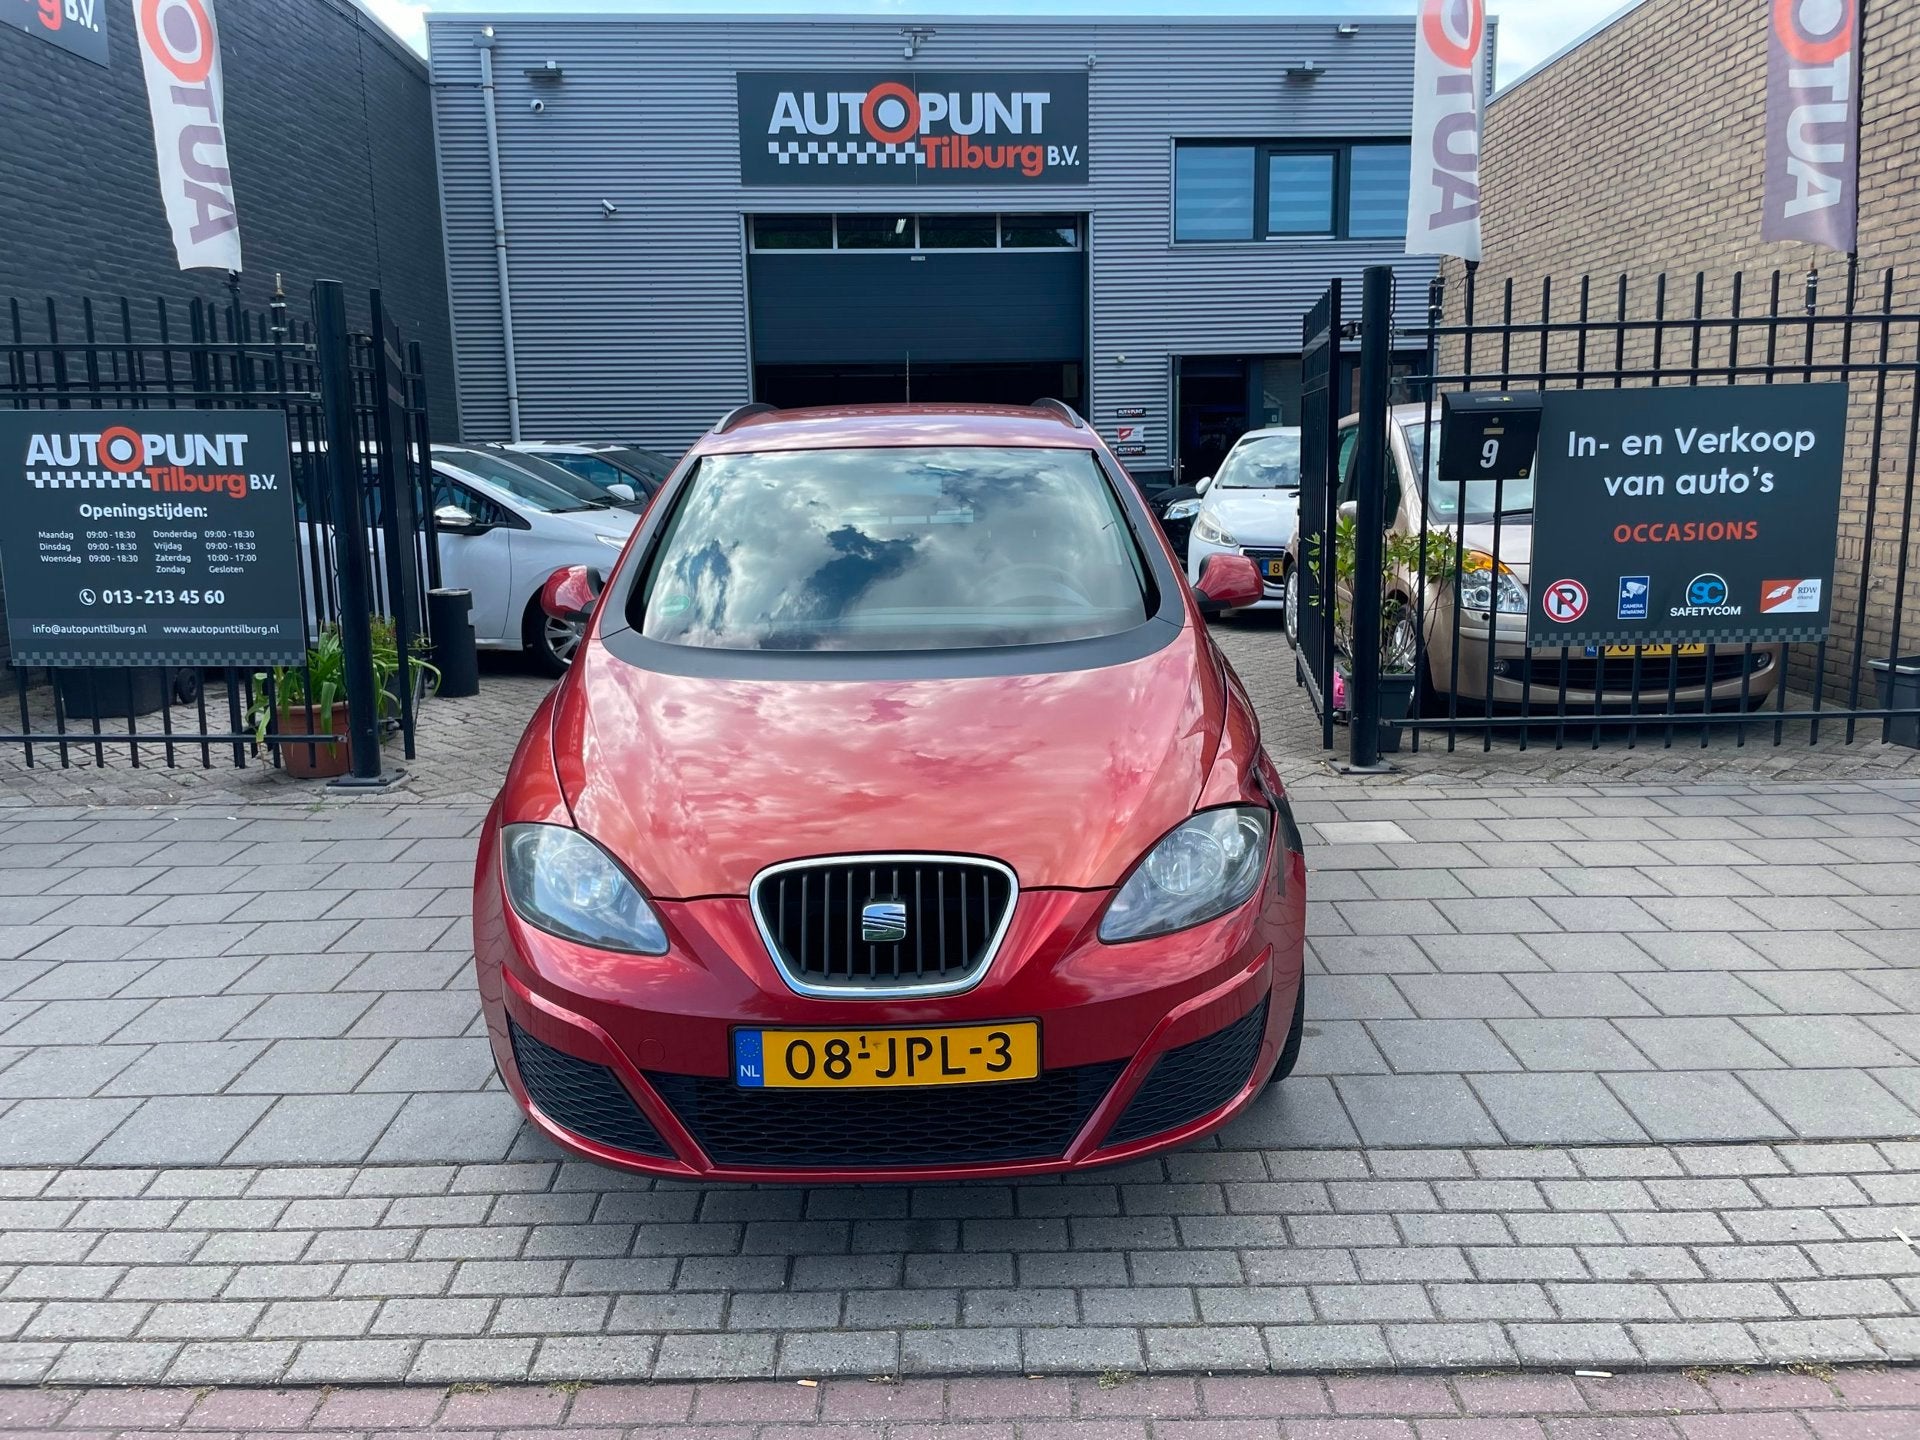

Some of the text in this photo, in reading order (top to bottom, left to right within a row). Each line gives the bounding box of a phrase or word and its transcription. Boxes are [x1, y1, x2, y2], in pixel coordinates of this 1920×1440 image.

[767, 82, 1051, 144] AUTOPUNT
[920, 135, 1080, 177] Tilburg B.V.
[1567, 425, 1817, 459] In- en Verkoop
[26, 426, 248, 473] AUTOPUNT
[1480, 439, 1499, 468] 9
[146, 467, 278, 498] Tilburg B.V.
[1603, 466, 1774, 498] van auto's
[79, 503, 208, 521] Openingstijden:
[38, 531, 74, 540] Maandag
[86, 531, 108, 539] 09:00
[115, 531, 136, 539] 18:30
[153, 530, 197, 540] Donderdag
[204, 530, 227, 539] 09:00
[233, 530, 255, 539] 18:30
[1613, 520, 1758, 544] OCCASIONS
[39, 543, 71, 552] Dinsdag
[87, 543, 109, 551] 09:00
[116, 543, 137, 551] 18:30
[154, 542, 182, 552] Vrijdag
[205, 542, 228, 551] 09:00
[234, 542, 256, 551] 18:30
[40, 555, 82, 564] Woensdag
[88, 555, 110, 563] 09:00
[117, 555, 138, 563] 18:30
[155, 554, 191, 564] Zaterdag
[207, 554, 229, 562] 10:00
[235, 554, 257, 562] 17:00
[156, 565, 244, 575] Zondag Gesloten
[179, 589, 199, 604] 45
[204, 589, 225, 604] 60
[1669, 605, 1742, 617] SAFETYCOM
[32, 624, 280, 635] info@autopunttilburg.nl www.autopunttilburg.nl
[739, 1064, 760, 1078] NL
